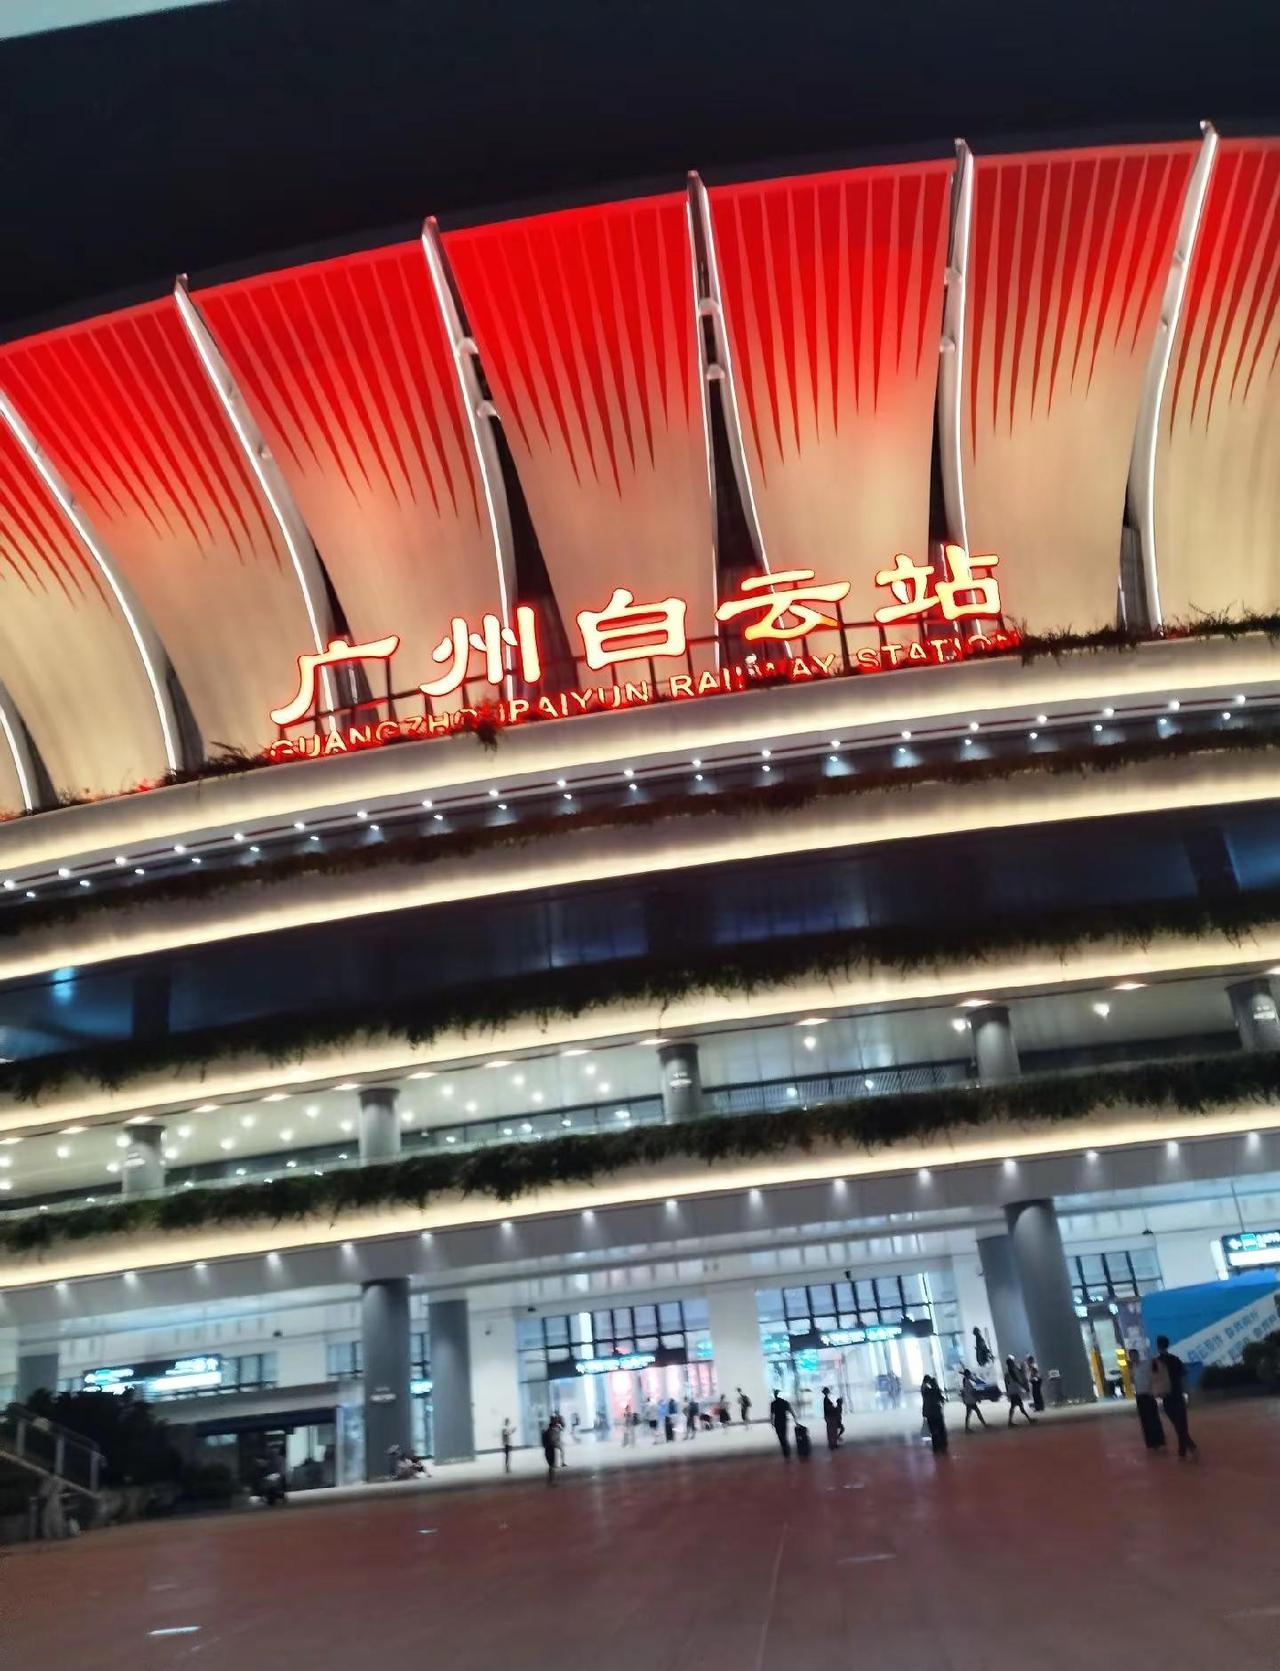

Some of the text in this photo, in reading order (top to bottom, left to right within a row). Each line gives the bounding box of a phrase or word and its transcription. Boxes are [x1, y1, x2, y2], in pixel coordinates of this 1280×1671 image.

[270, 544, 1001, 724] 广州白云站
[669, 653, 835, 698] RAIAY
